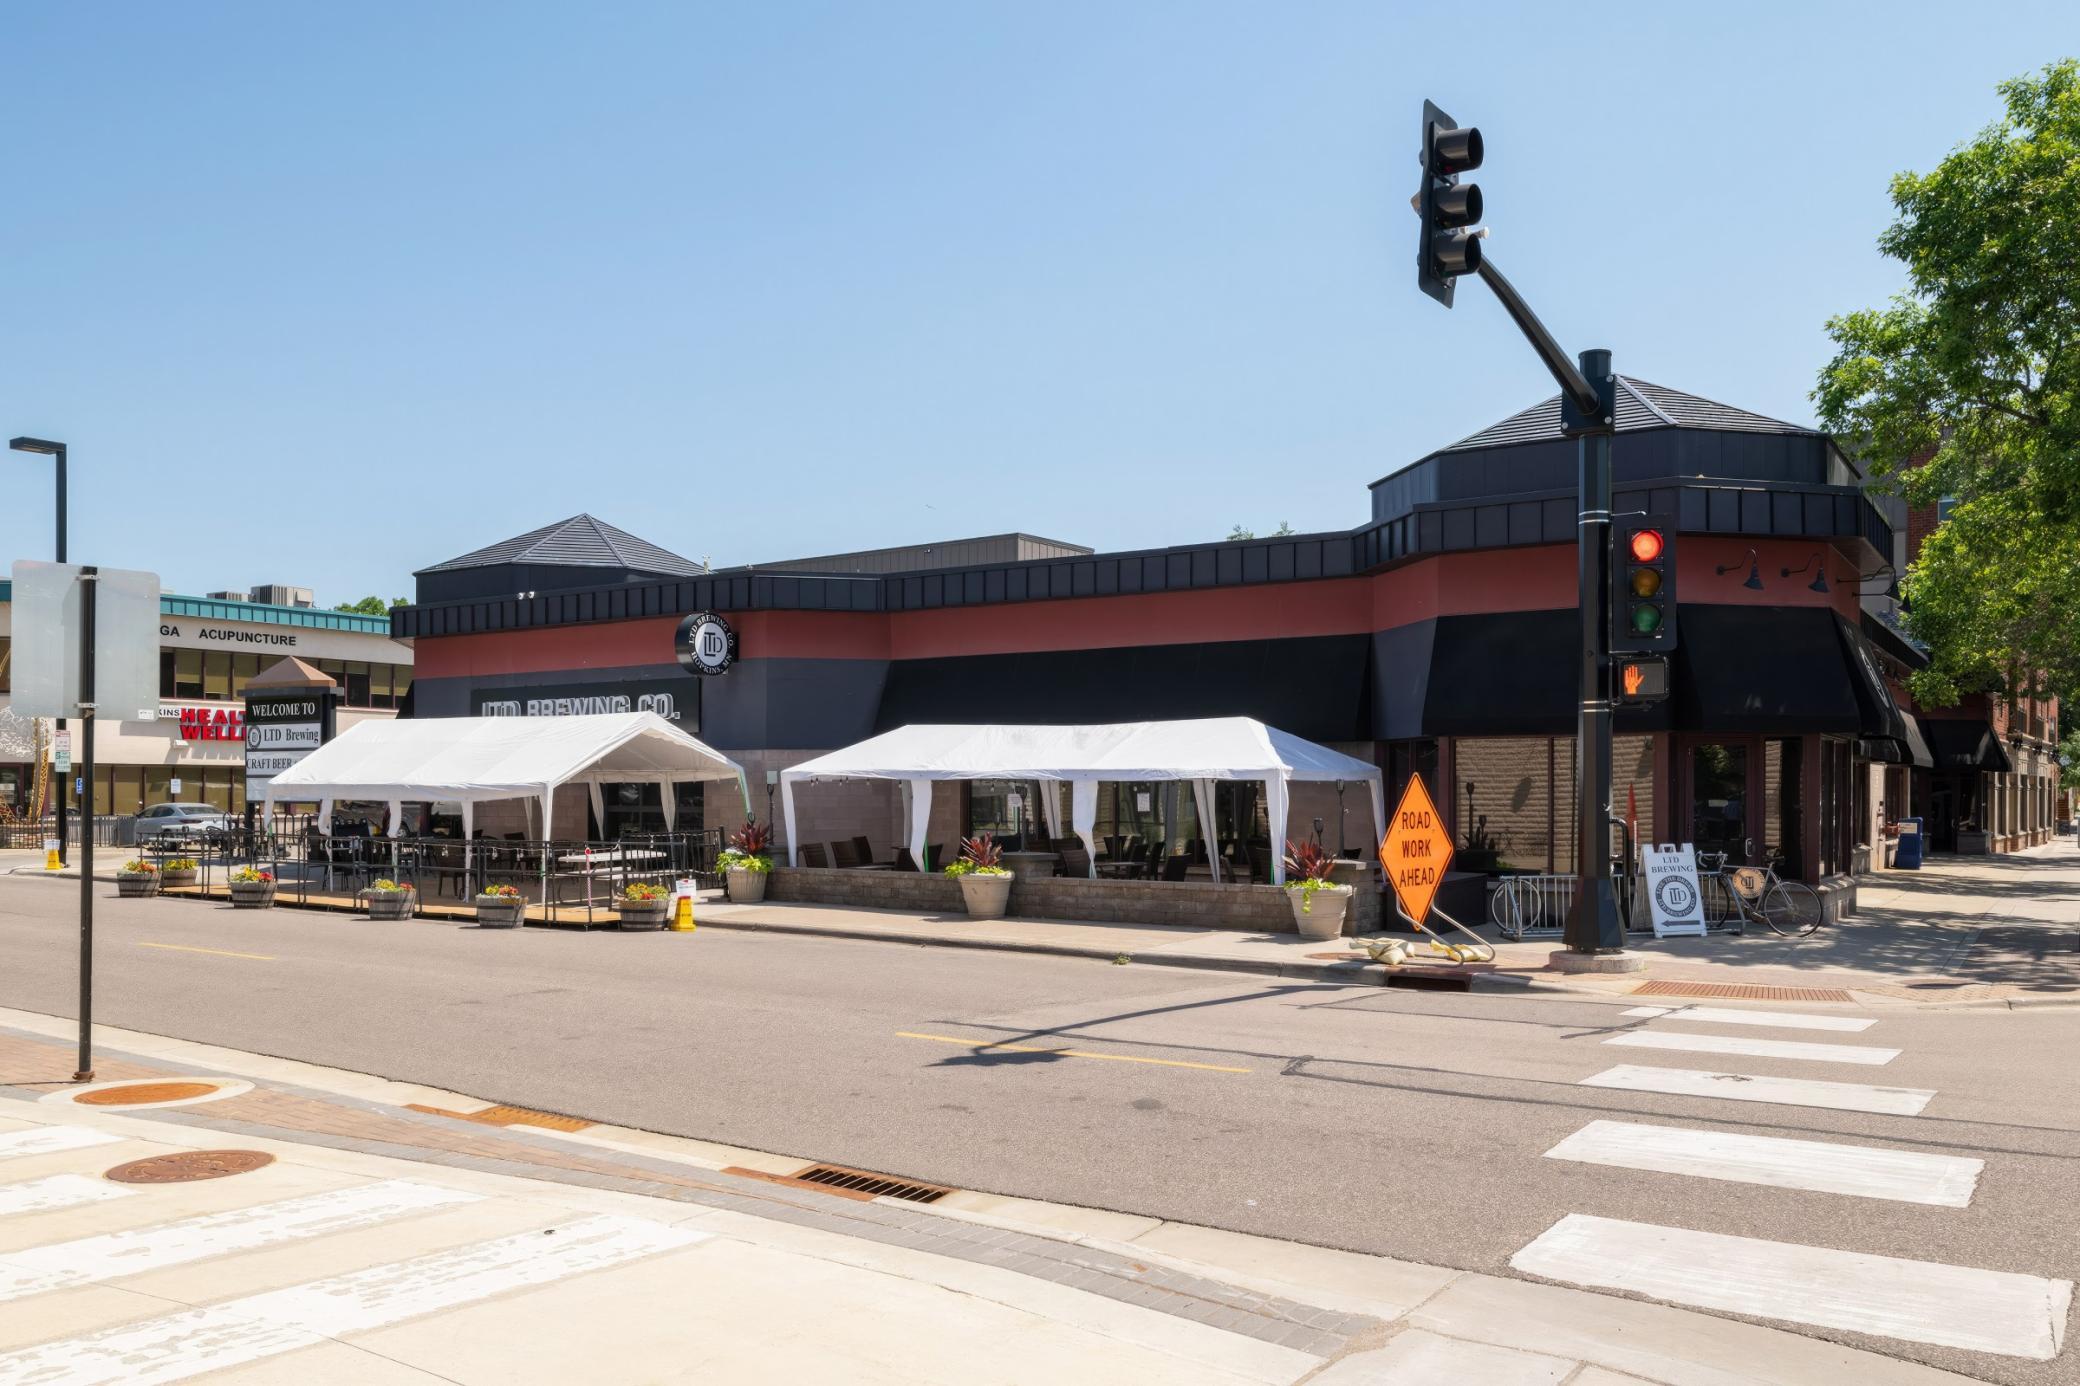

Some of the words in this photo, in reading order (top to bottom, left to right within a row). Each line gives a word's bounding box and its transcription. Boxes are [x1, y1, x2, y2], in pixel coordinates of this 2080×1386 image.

[199, 628, 297, 646] ACUPUNCTURE
[689, 625, 698, 644] LTD
[696, 614, 728, 631] BREWING
[703, 631, 723, 657] LTD
[252, 703, 300, 717] WELCOME
[302, 702, 316, 715] TO
[527, 696, 631, 717] BREWING
[637, 692, 681, 720] CO.
[264, 728, 281, 742] LTD
[286, 727, 318, 744] Brewing
[247, 758, 271, 770] CRAFT
[272, 757, 292, 769] BEER
[1402, 811, 1431, 830] ROAD
[1402, 839, 1432, 858] WORK
[1651, 865, 1694, 873] BREWING
[1662, 856, 1679, 864] LTD
[1400, 867, 1435, 888] AHEAD
[1669, 887, 1687, 905] LTD
